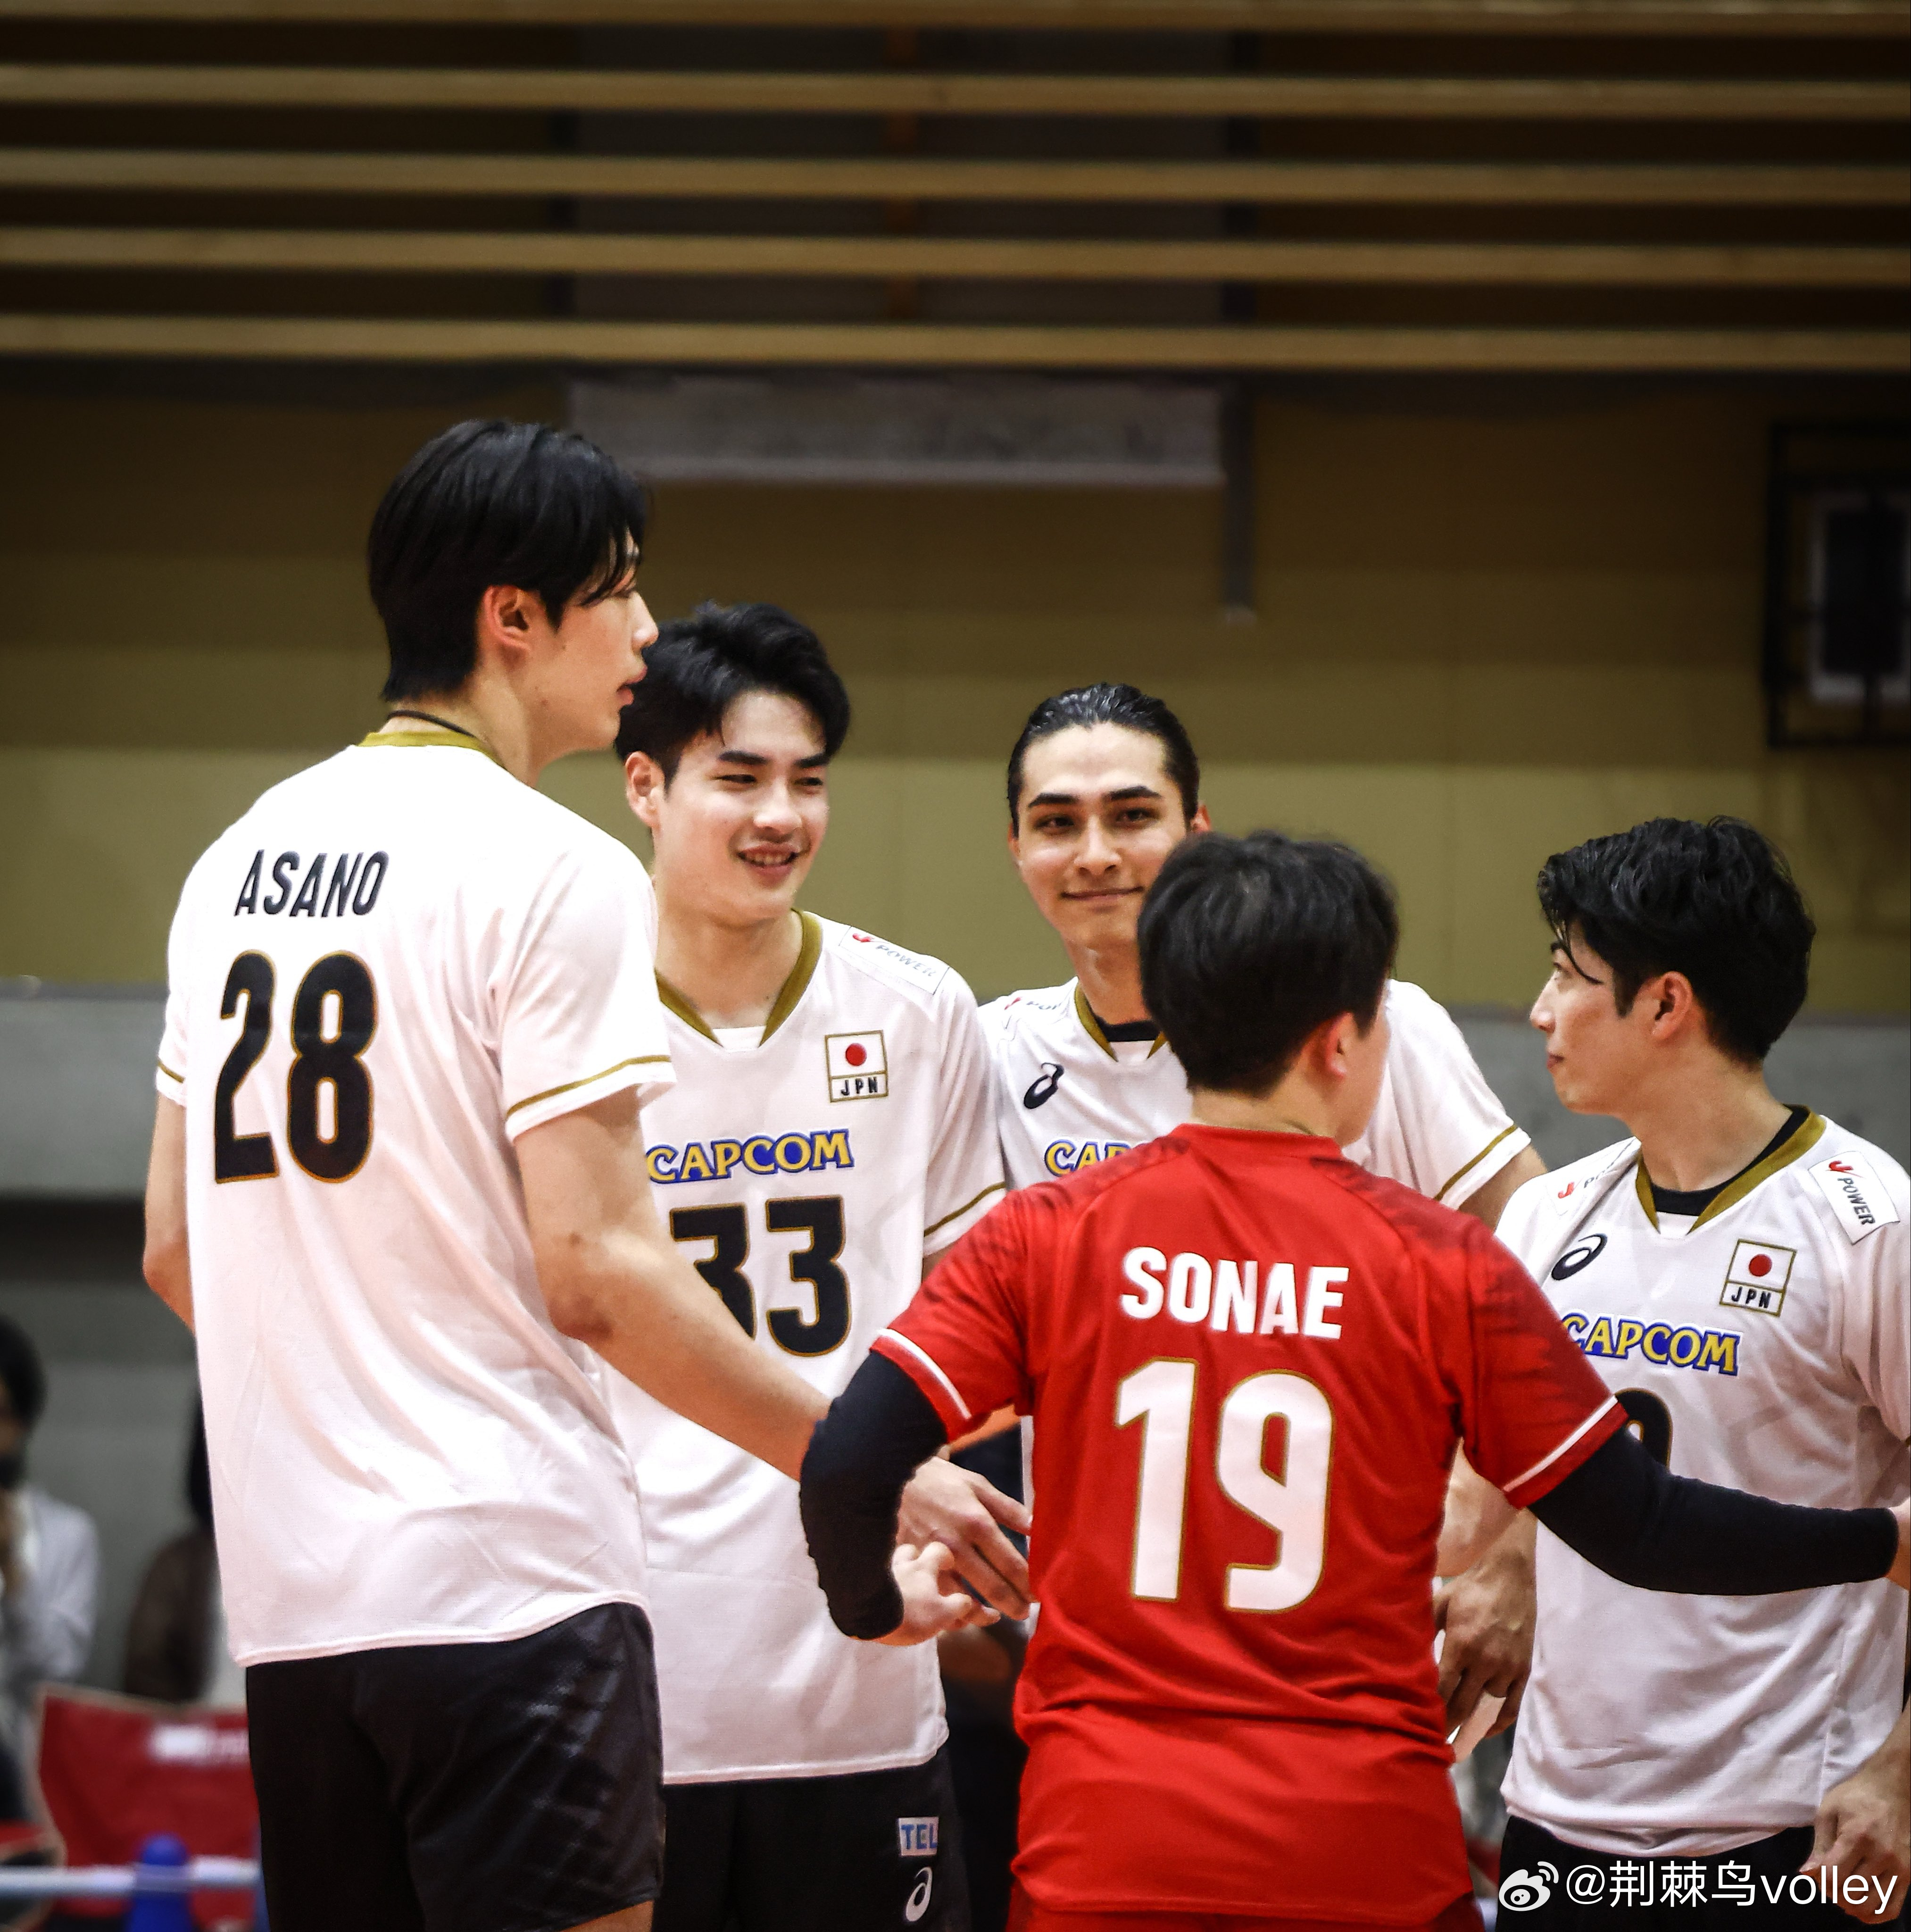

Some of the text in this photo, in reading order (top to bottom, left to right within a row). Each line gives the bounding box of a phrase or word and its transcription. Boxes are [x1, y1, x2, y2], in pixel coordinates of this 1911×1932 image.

[234, 849, 390, 918] ASANO
[215, 949, 378, 1184] 28
[840, 1076, 878, 1096] JPN
[646, 1128, 855, 1184] CAPCOM
[1837, 1177, 1876, 1225] POWER
[669, 1194, 851, 1357] 33
[1119, 1246, 1350, 1340] SONAE
[1731, 1286, 1771, 1308] JPN
[1115, 1355, 1334, 1614] 19
[900, 1823, 937, 1850] TEL
